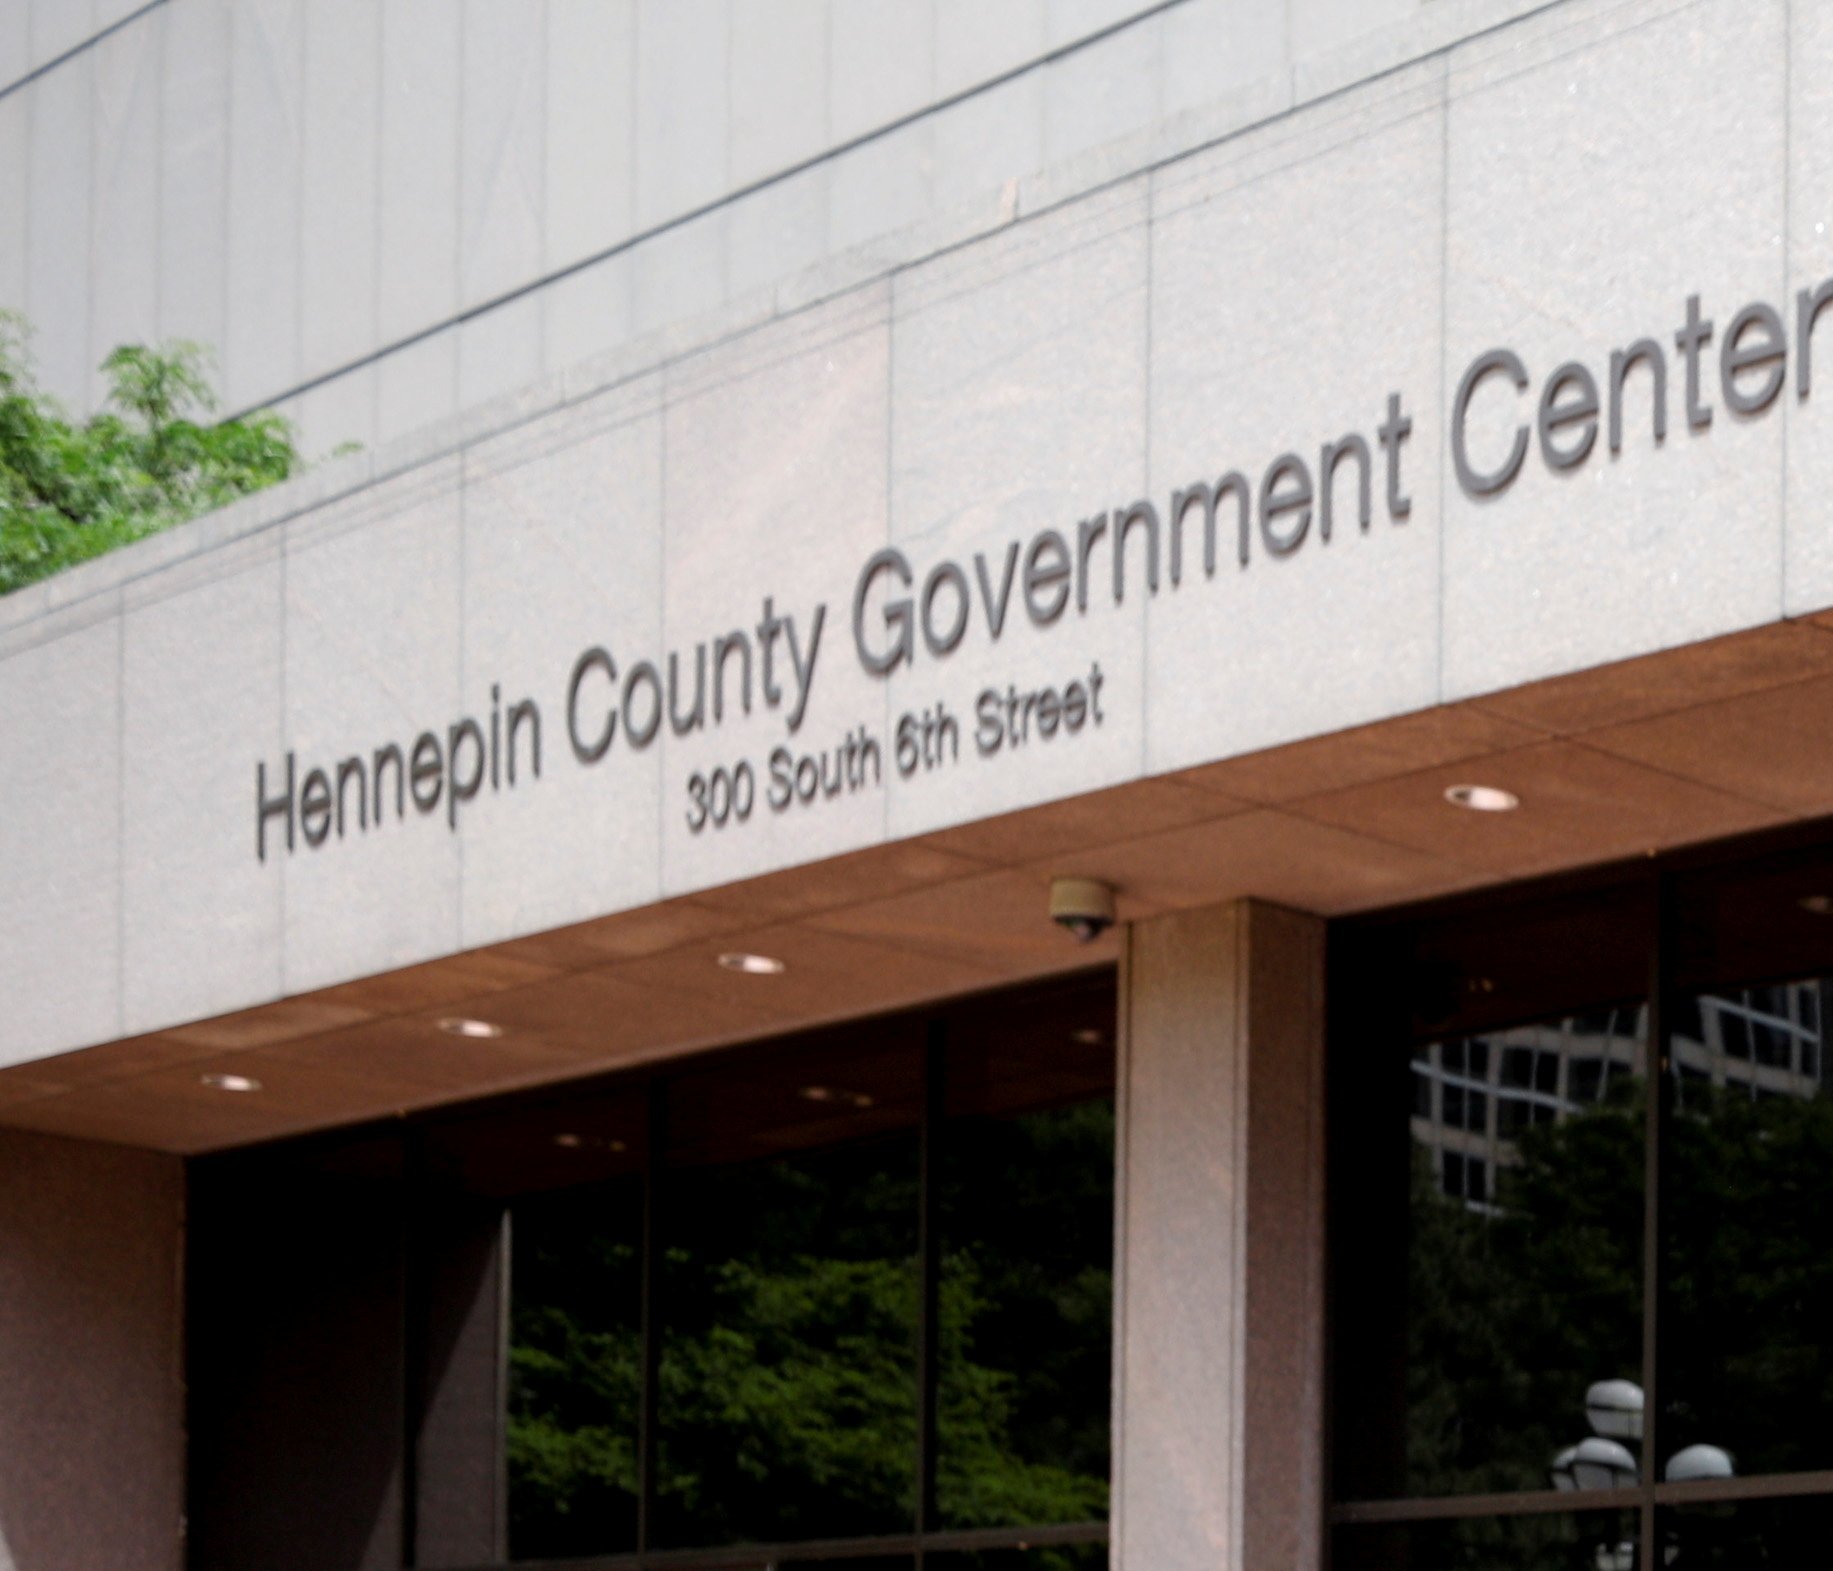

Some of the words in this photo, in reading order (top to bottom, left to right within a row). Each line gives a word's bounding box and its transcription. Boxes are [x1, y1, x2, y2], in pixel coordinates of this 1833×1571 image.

[256, 683, 541, 863] Hennepin
[565, 597, 826, 765] County
[851, 392, 1413, 677] Government
[685, 760, 756, 834] 300
[765, 722, 882, 813] South
[894, 698, 959, 776] 6th
[974, 661, 1106, 755] Street
